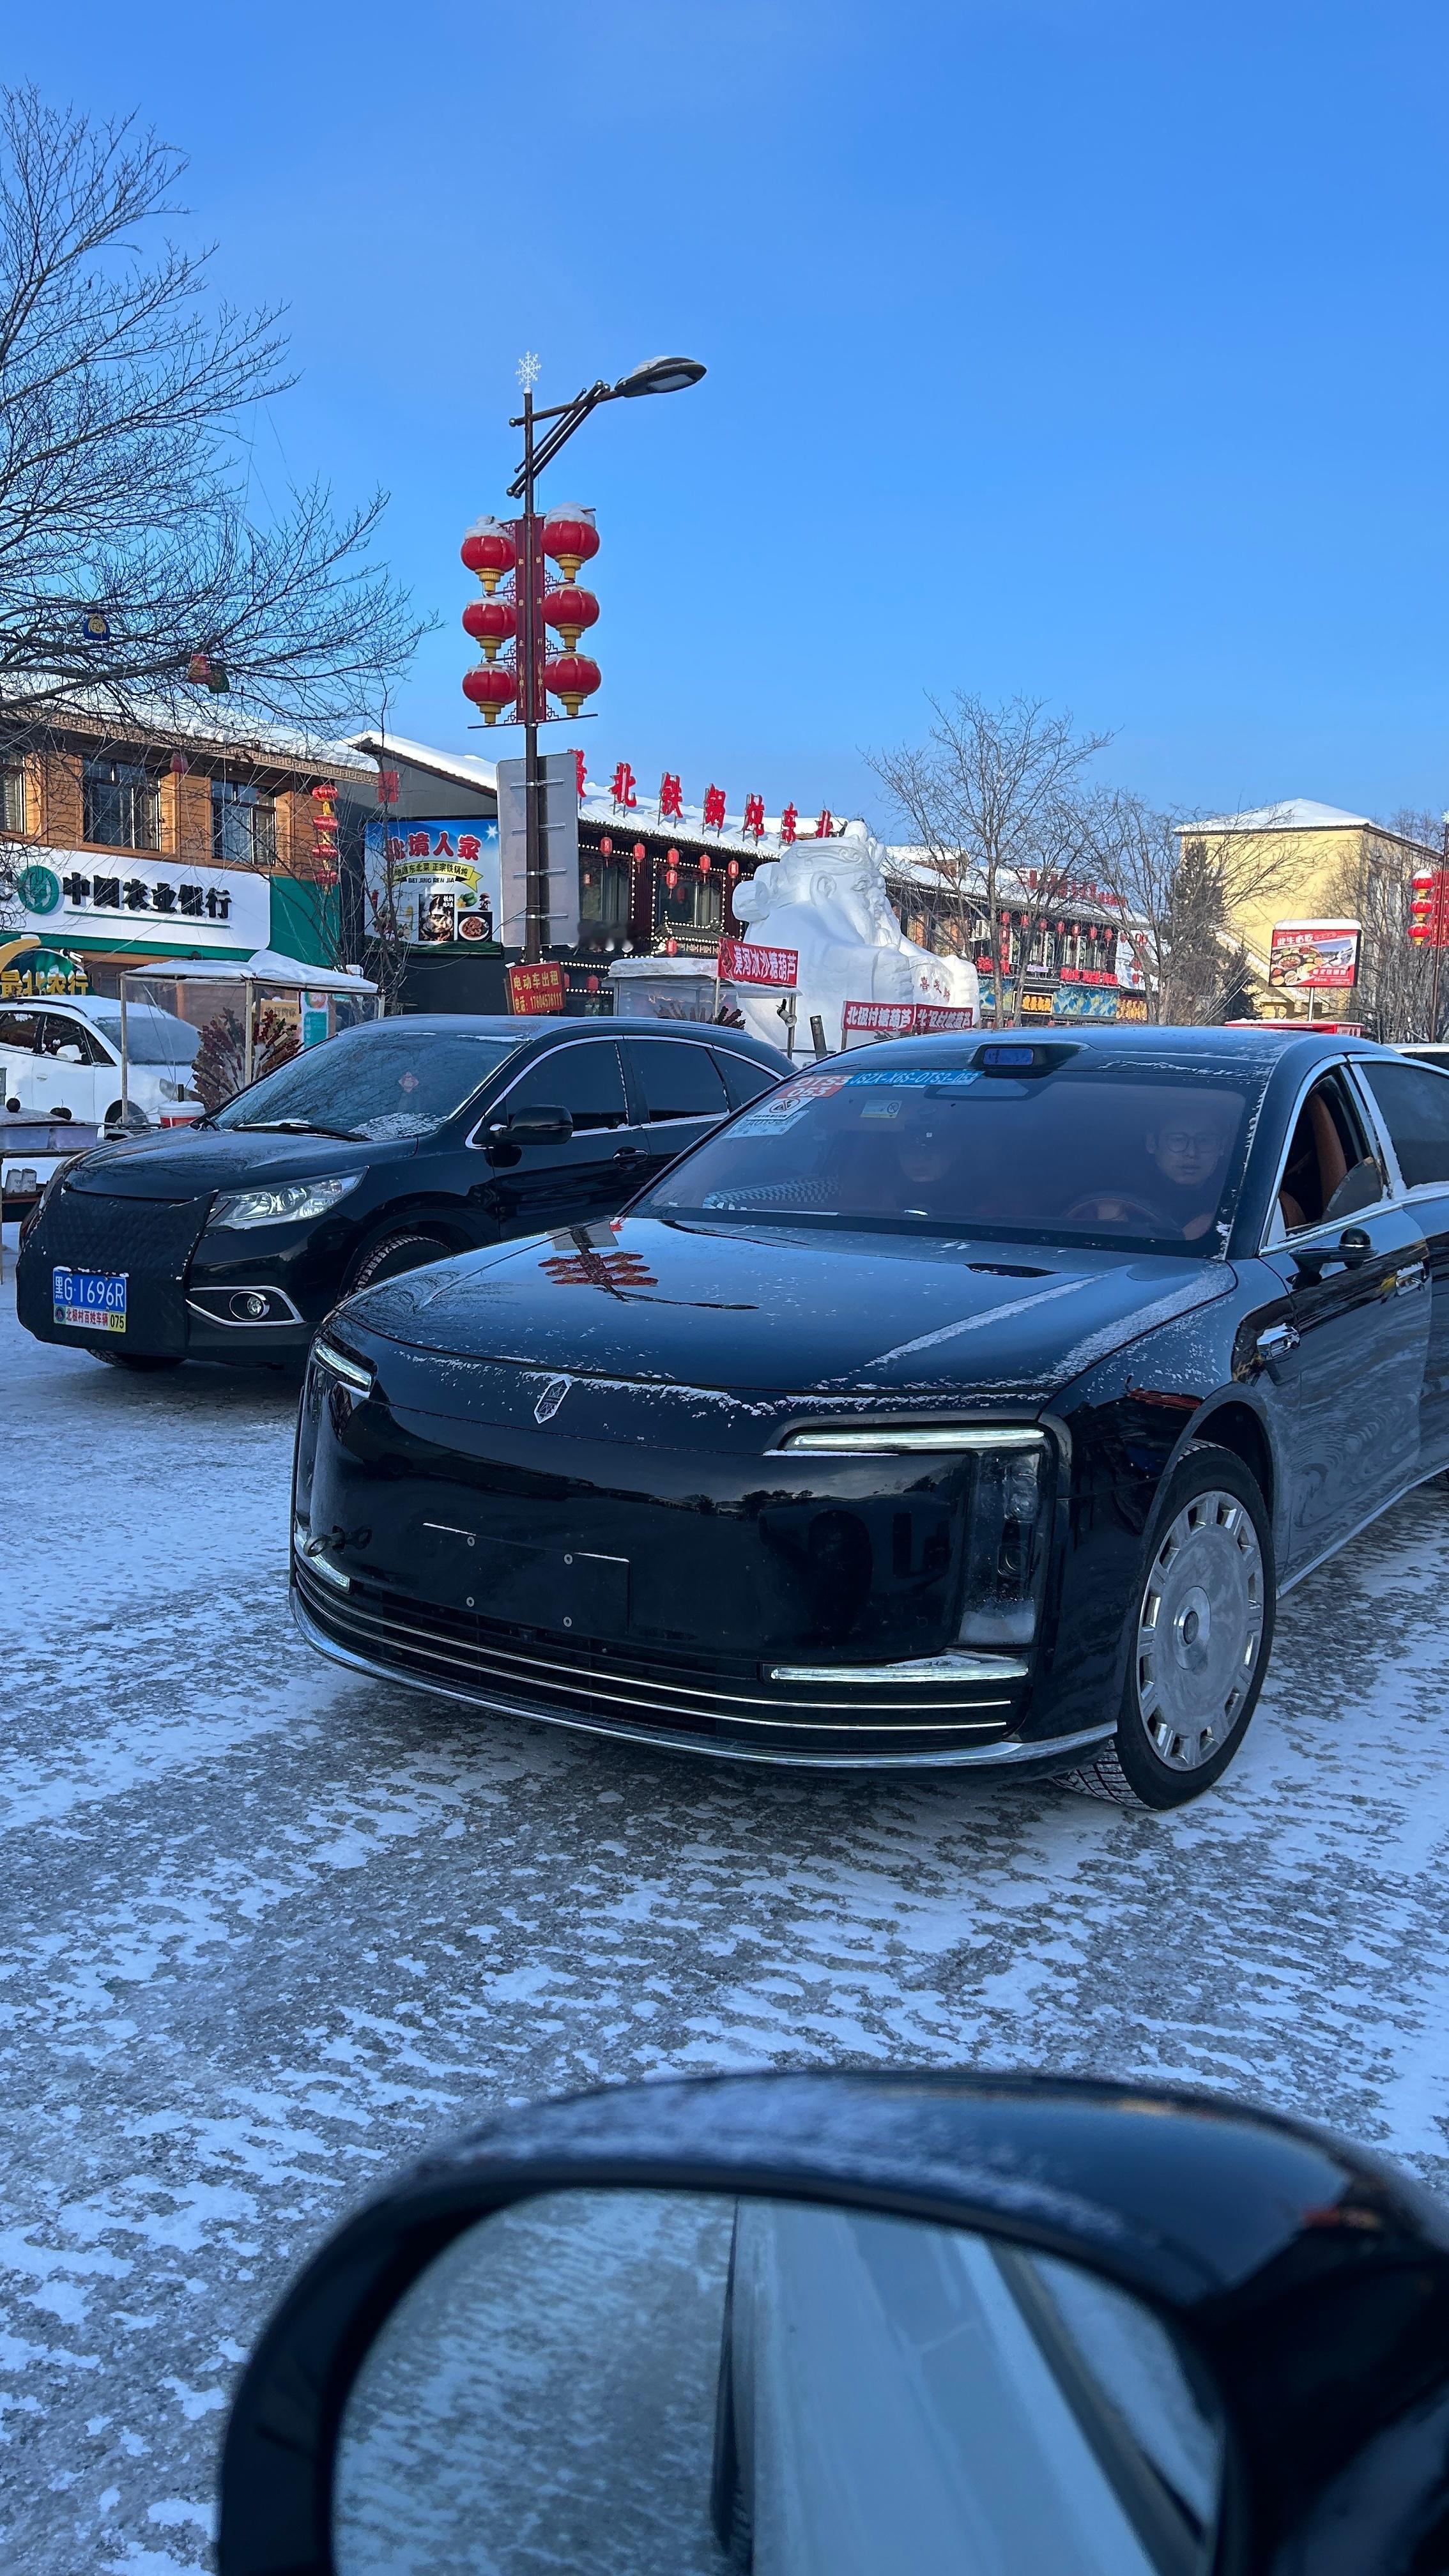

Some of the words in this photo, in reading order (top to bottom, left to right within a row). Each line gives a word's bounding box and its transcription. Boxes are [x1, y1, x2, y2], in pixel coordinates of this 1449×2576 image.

[433, 862, 468, 876] 正宗铁锅炖
[63, 872, 232, 919] 中国农业银行
[513, 970, 559, 991] 电动车出租
[847, 1005, 912, 1029] 北极村糖葫芦
[787, 1087, 832, 1098] 053
[110, 1314, 125, 1329] 075
